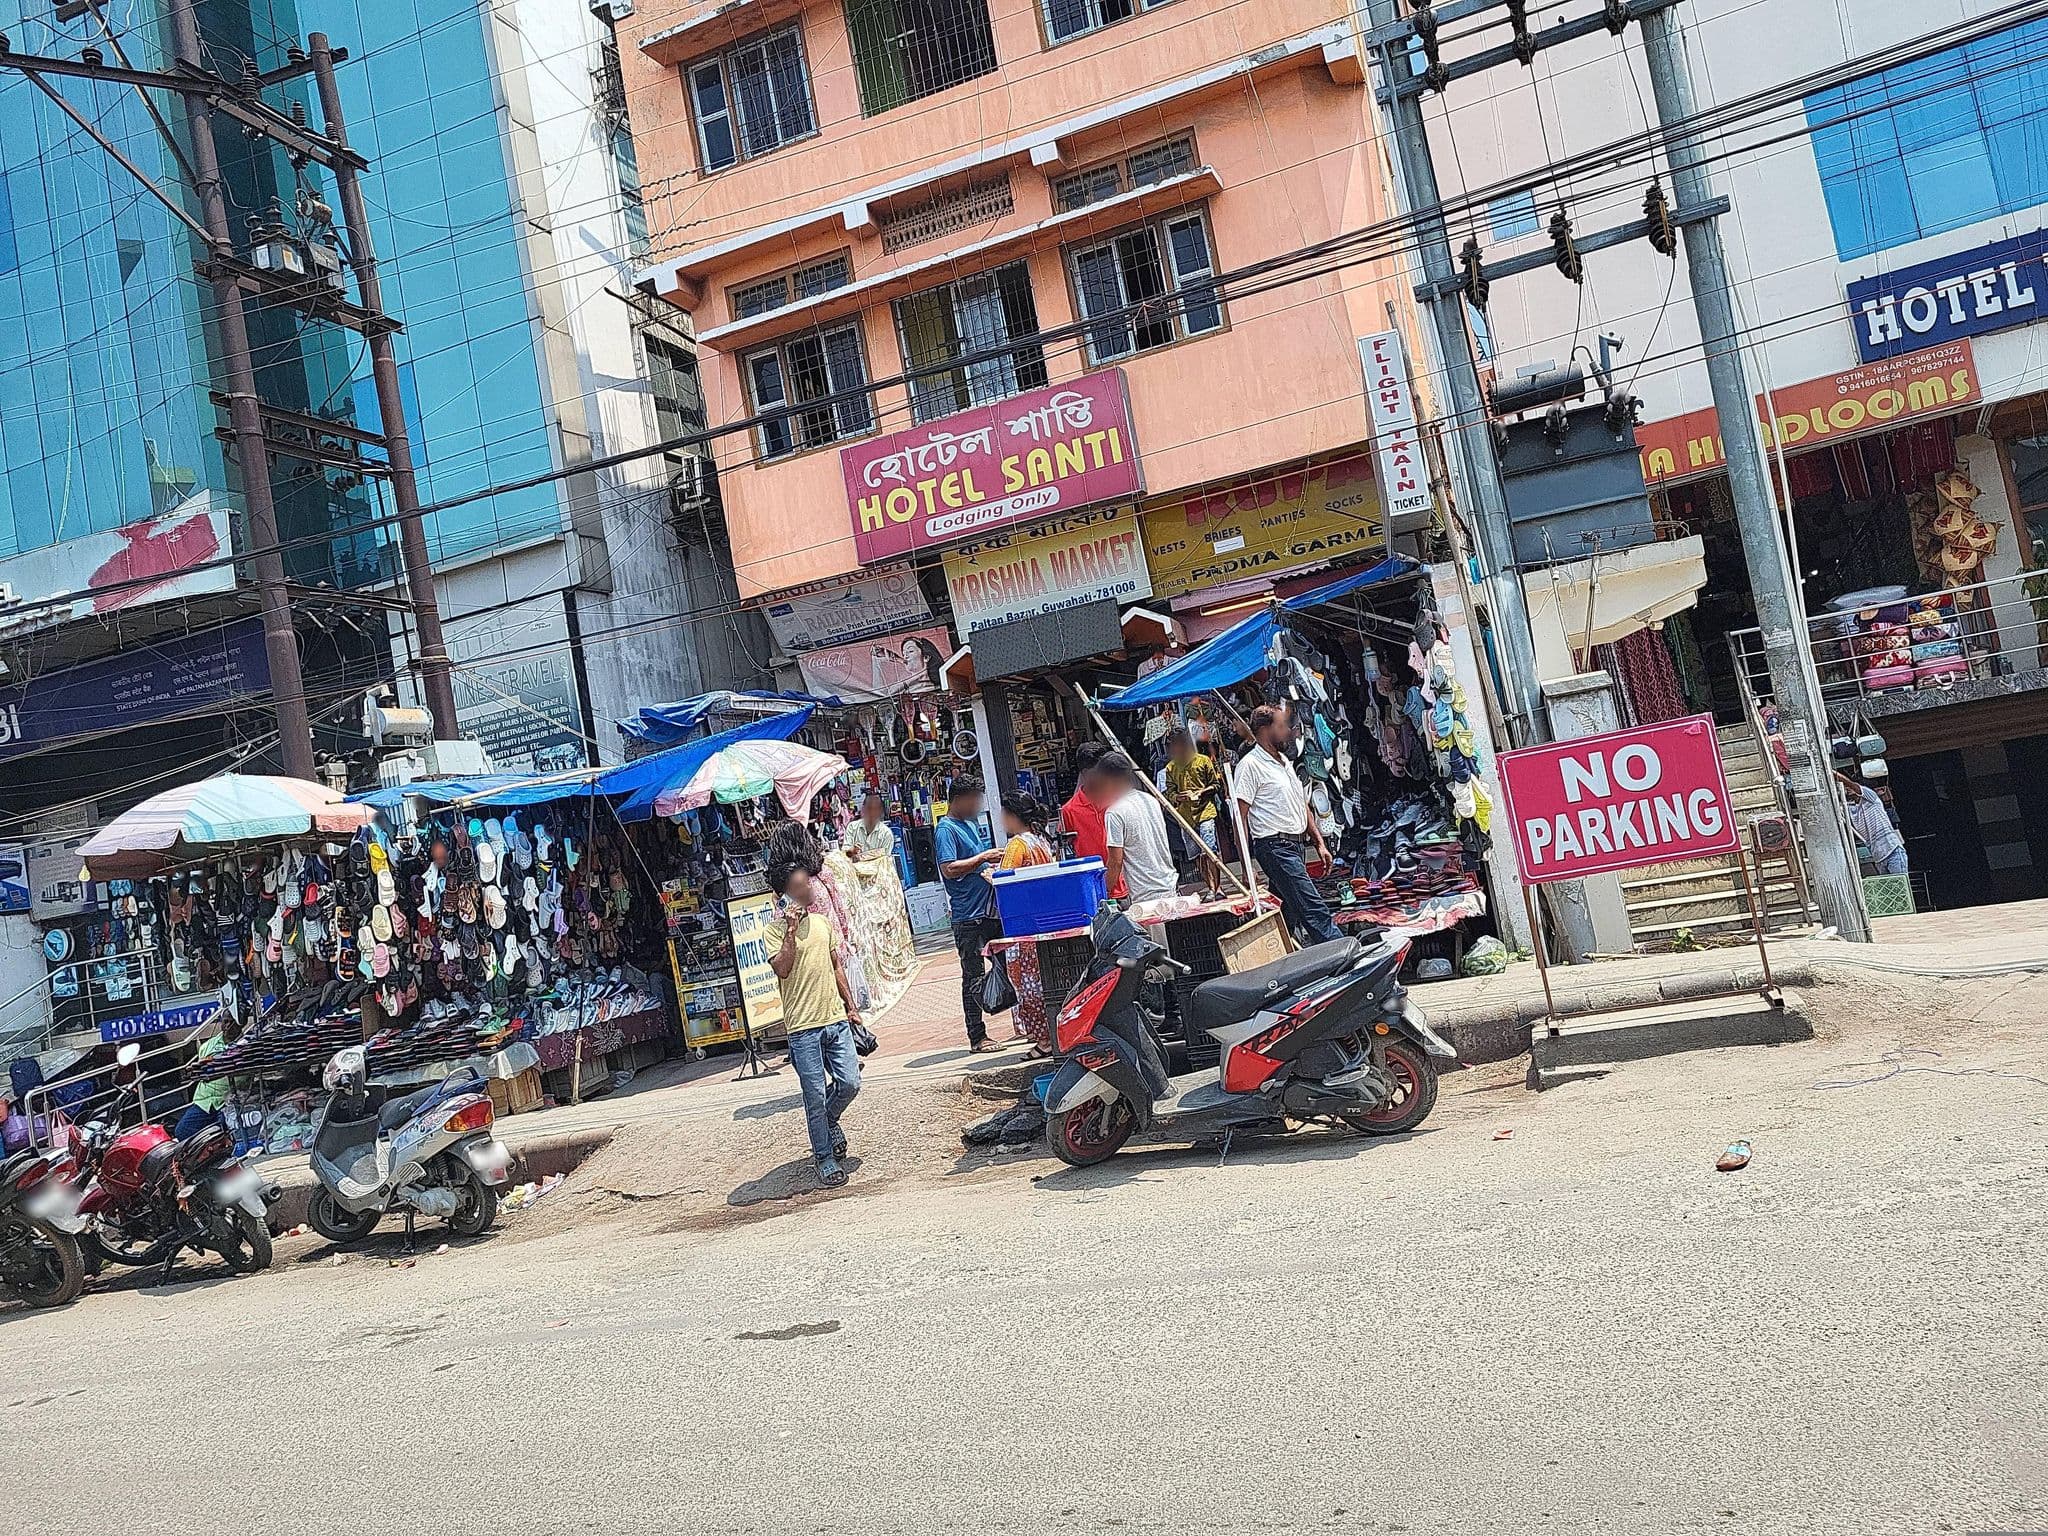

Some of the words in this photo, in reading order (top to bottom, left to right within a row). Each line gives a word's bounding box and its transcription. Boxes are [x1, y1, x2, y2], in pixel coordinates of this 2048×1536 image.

[1862, 261, 2035, 345] HOTEL
[1835, 371, 1864, 385] GSTIN
[863, 426, 994, 488] হোটেল
[1004, 390, 1095, 441] শান্তি
[1373, 338, 1400, 414] FLIGHT
[1389, 428, 1416, 492] TRAIN
[857, 467, 986, 533] HOTEL
[1001, 427, 1124, 494] SANTI
[932, 502, 1004, 532] Lodging
[1011, 489, 1054, 511] Only
[1182, 453, 1376, 527] RUPA
[1394, 494, 1426, 511] TICKET
[1152, 540, 1187, 556] VESTS
[1204, 526, 1242, 543] BRIEFS
[1260, 509, 1306, 528] PANTIES
[1325, 494, 1364, 511] SOCKS
[952, 557, 1049, 616] KRISHNA
[1049, 531, 1139, 591] MARKET
[1192, 550, 1281, 582] PADMA
[804, 605, 868, 633] RAILWAY
[867, 590, 921, 615] TICKET
[883, 608, 913, 621] Internet
[970, 615, 1004, 632] Paltan
[1041, 580, 1137, 613] Guwahati-781008
[1558, 743, 1662, 803] NO
[1525, 788, 1723, 865] PARKING
